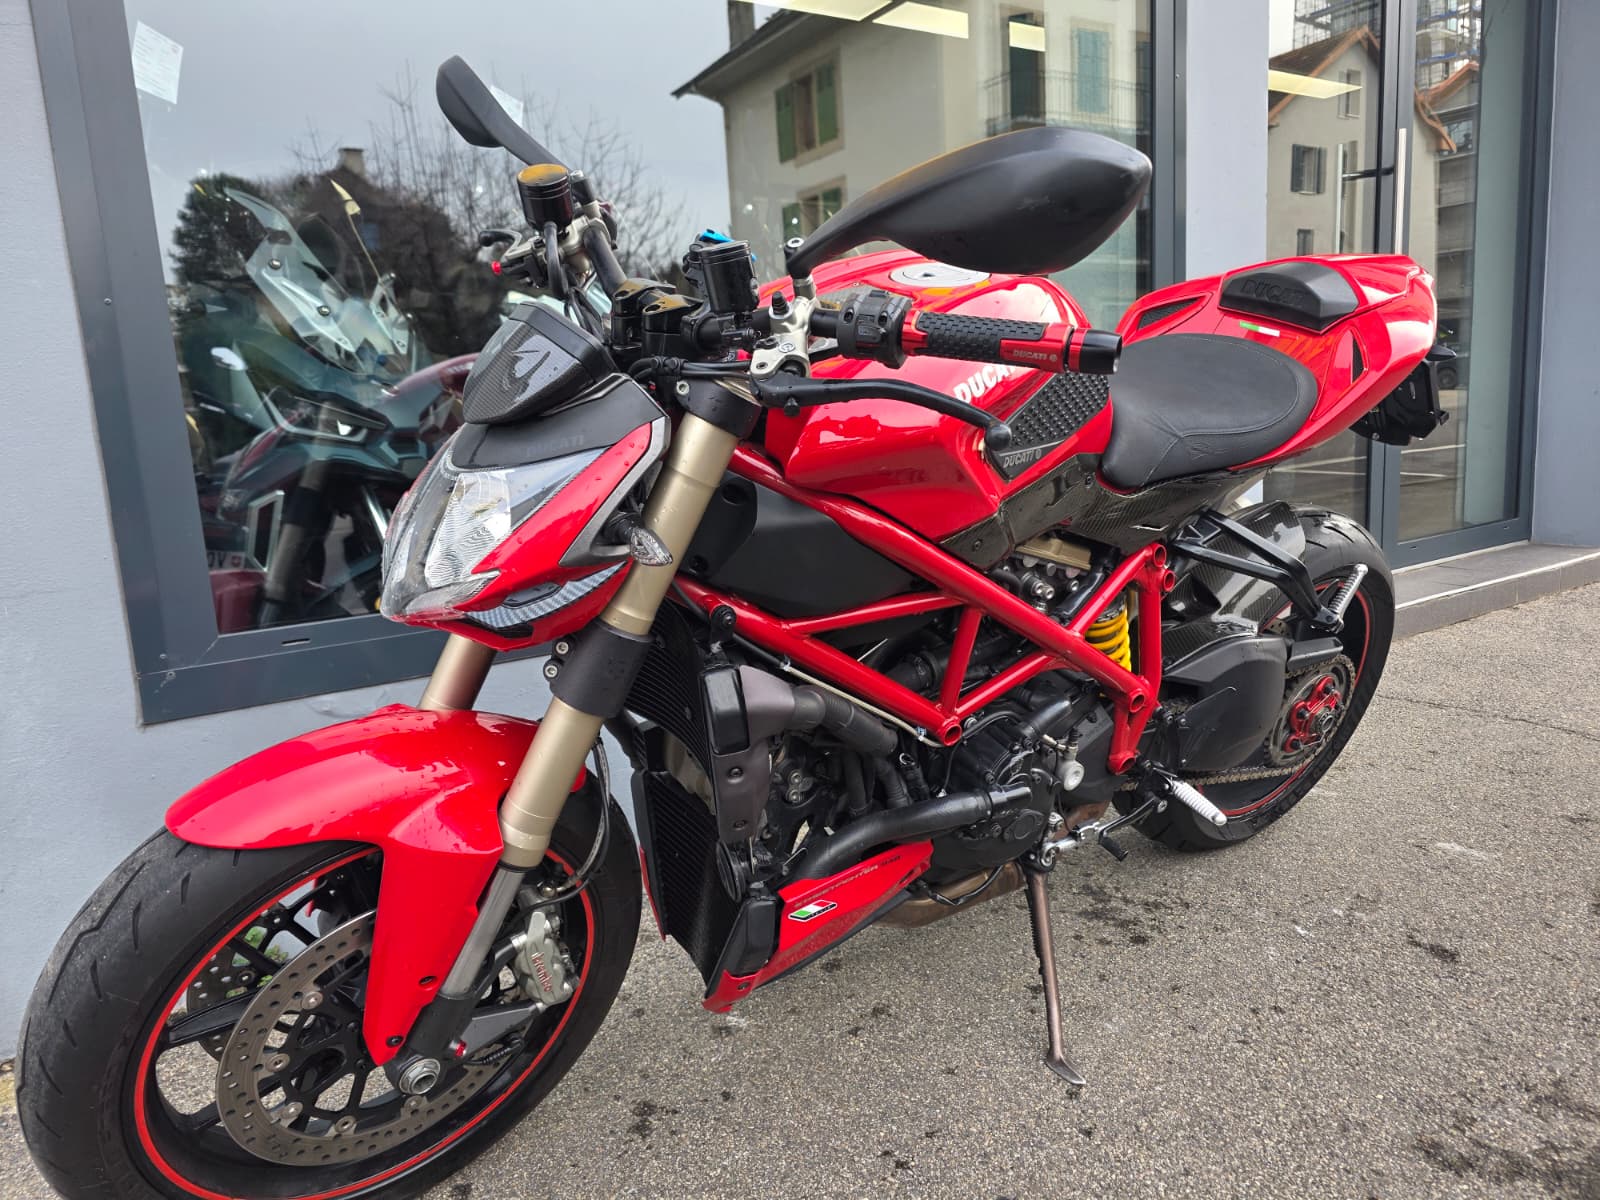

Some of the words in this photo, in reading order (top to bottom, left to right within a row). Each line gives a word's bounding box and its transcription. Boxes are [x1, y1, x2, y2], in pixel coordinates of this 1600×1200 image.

[1013, 349, 1047, 361] DUCATI
[953, 363, 1017, 403] DUCA
[1003, 450, 1034, 468] DUCATI
[531, 952, 552, 992] brembo
